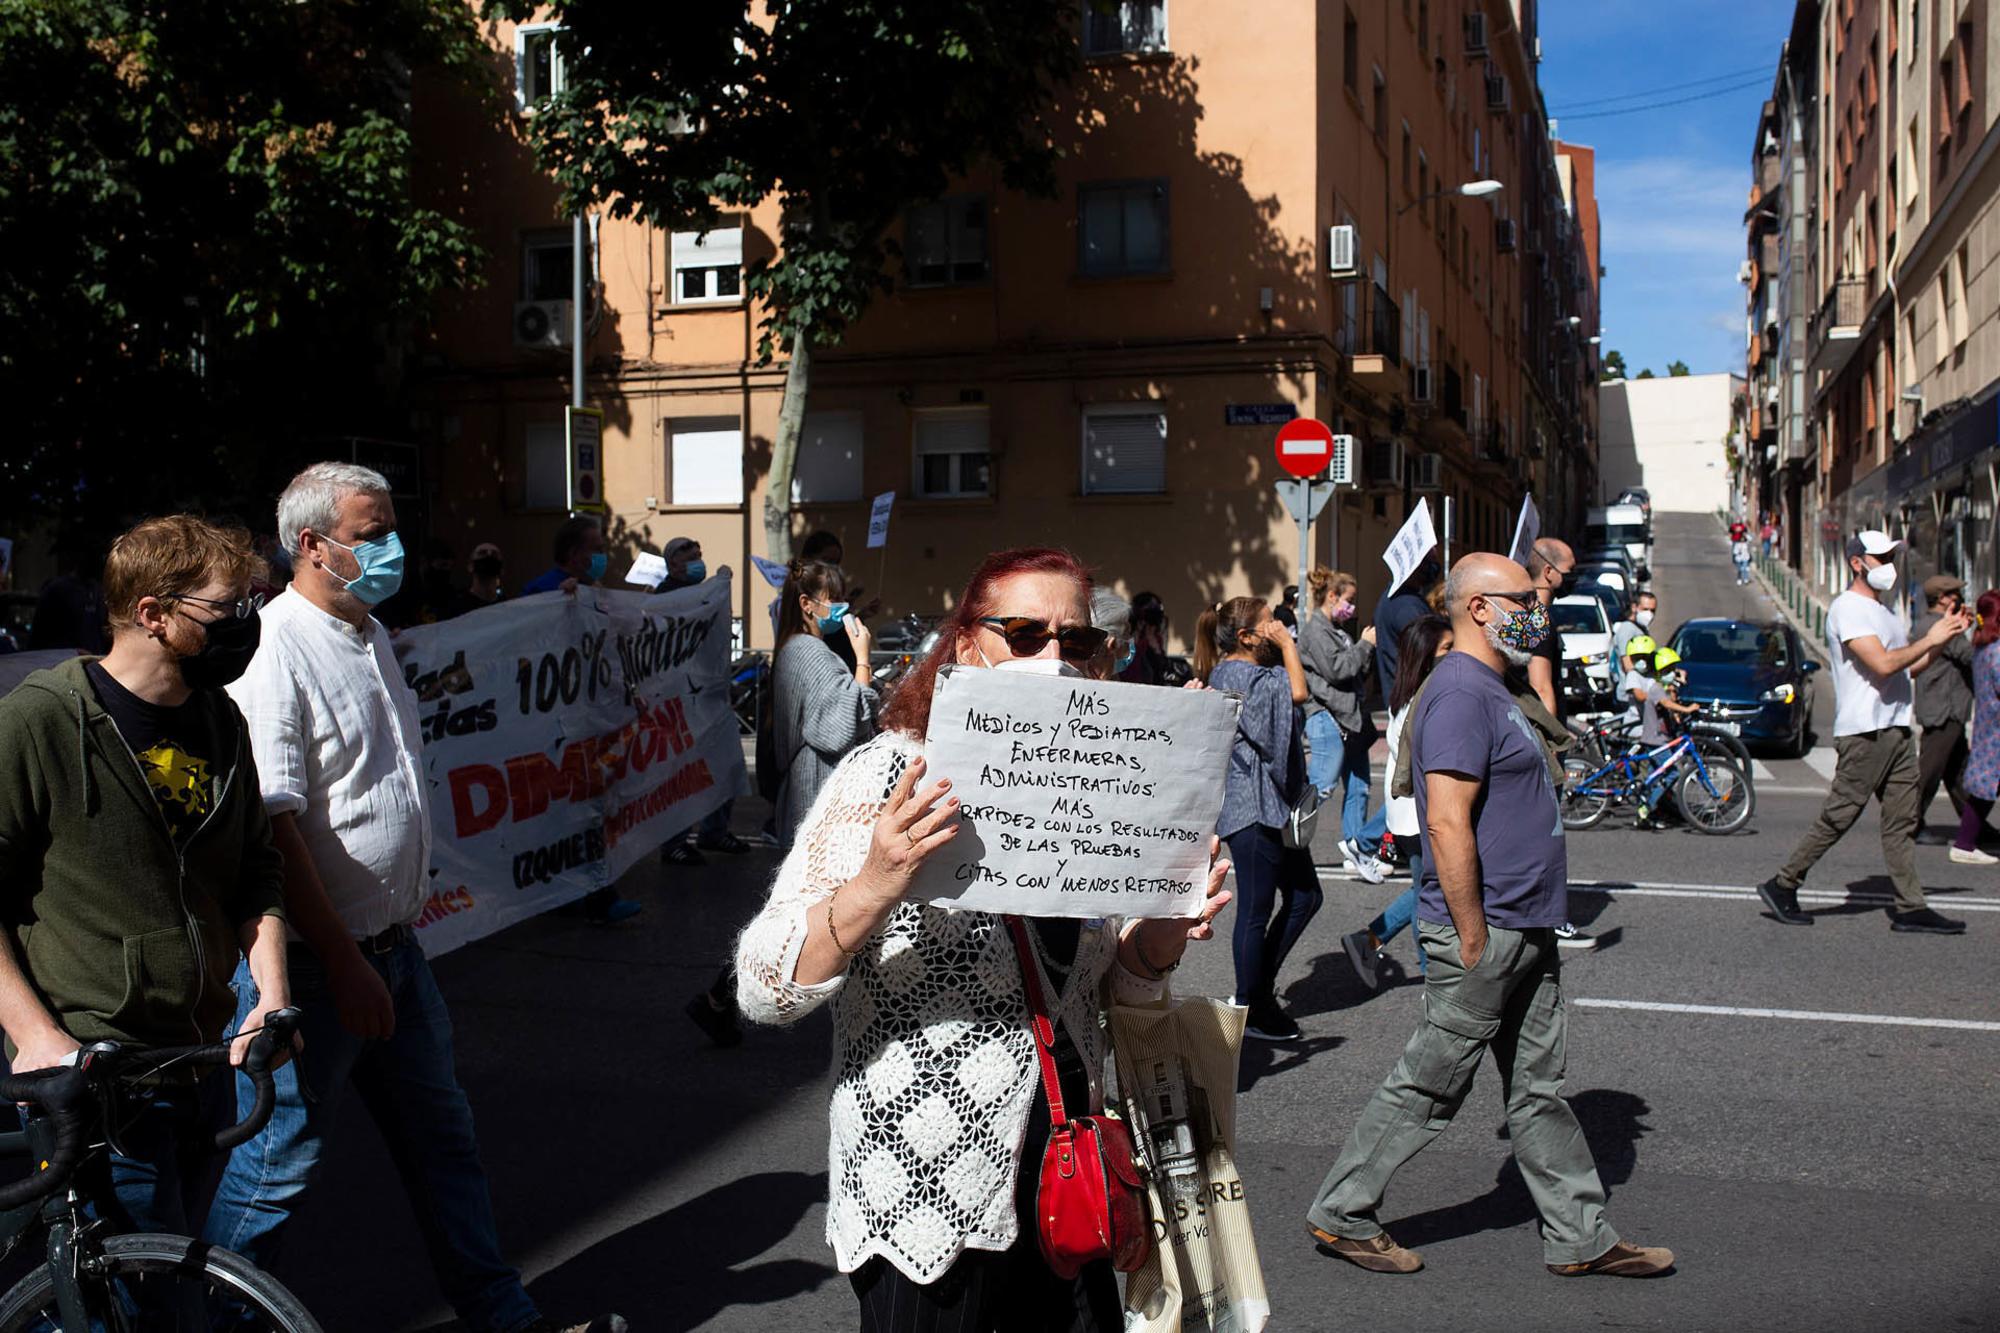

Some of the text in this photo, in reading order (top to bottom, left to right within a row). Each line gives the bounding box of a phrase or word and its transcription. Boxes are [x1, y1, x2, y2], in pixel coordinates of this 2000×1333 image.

[516, 629, 611, 714] 100%
[1065, 688, 1110, 716] MÁS
[1011, 740, 1146, 773] ENFERMERAS,
[1050, 796, 1094, 819] MÁS
[1043, 820, 1071, 833] CON
[1076, 823, 1103, 835] LOS
[1026, 839, 1060, 853] LAS
[1016, 873, 1050, 889] CON
[1060, 877, 1119, 893] MENOS
[1125, 876, 1193, 895] RETRASO
